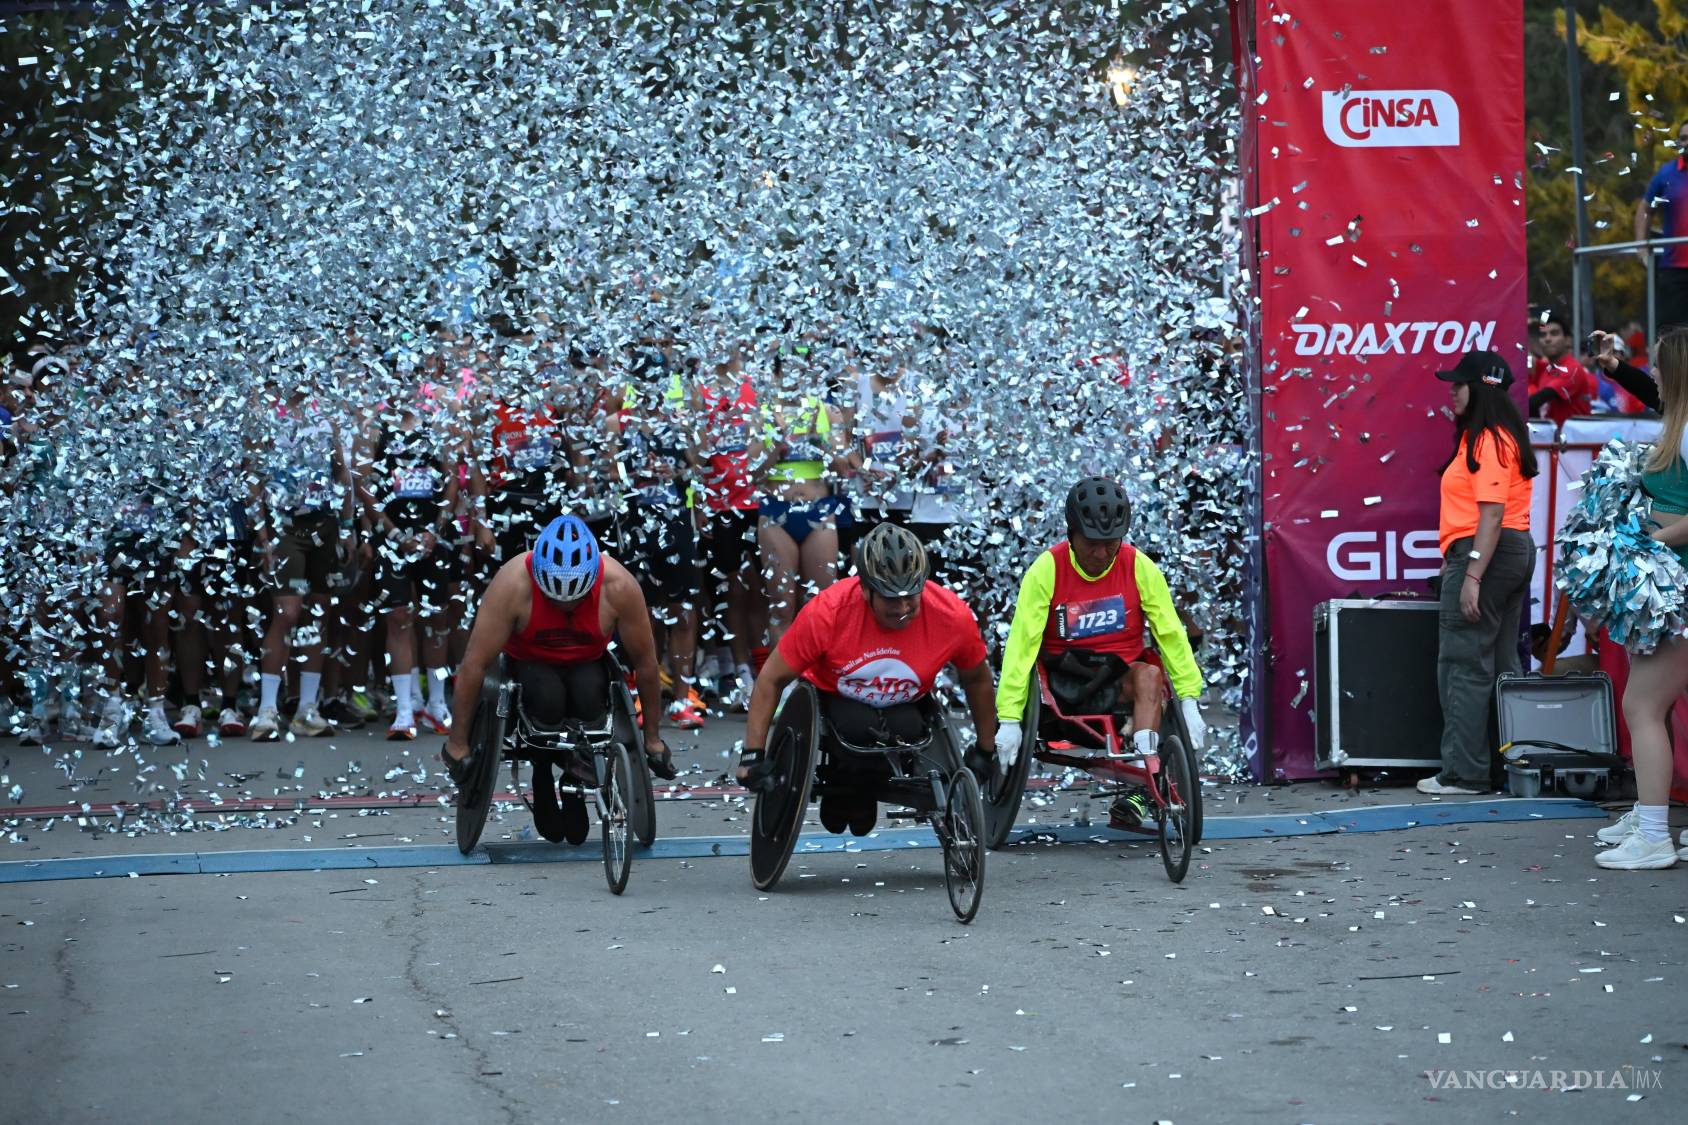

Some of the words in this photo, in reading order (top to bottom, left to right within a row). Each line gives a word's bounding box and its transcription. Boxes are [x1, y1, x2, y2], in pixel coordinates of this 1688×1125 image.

[1291, 321, 1496, 355] DRAXTON
[400, 478, 432, 491] 1026
[1327, 530, 1444, 581] GIS
[1079, 609, 1118, 630] 1723
